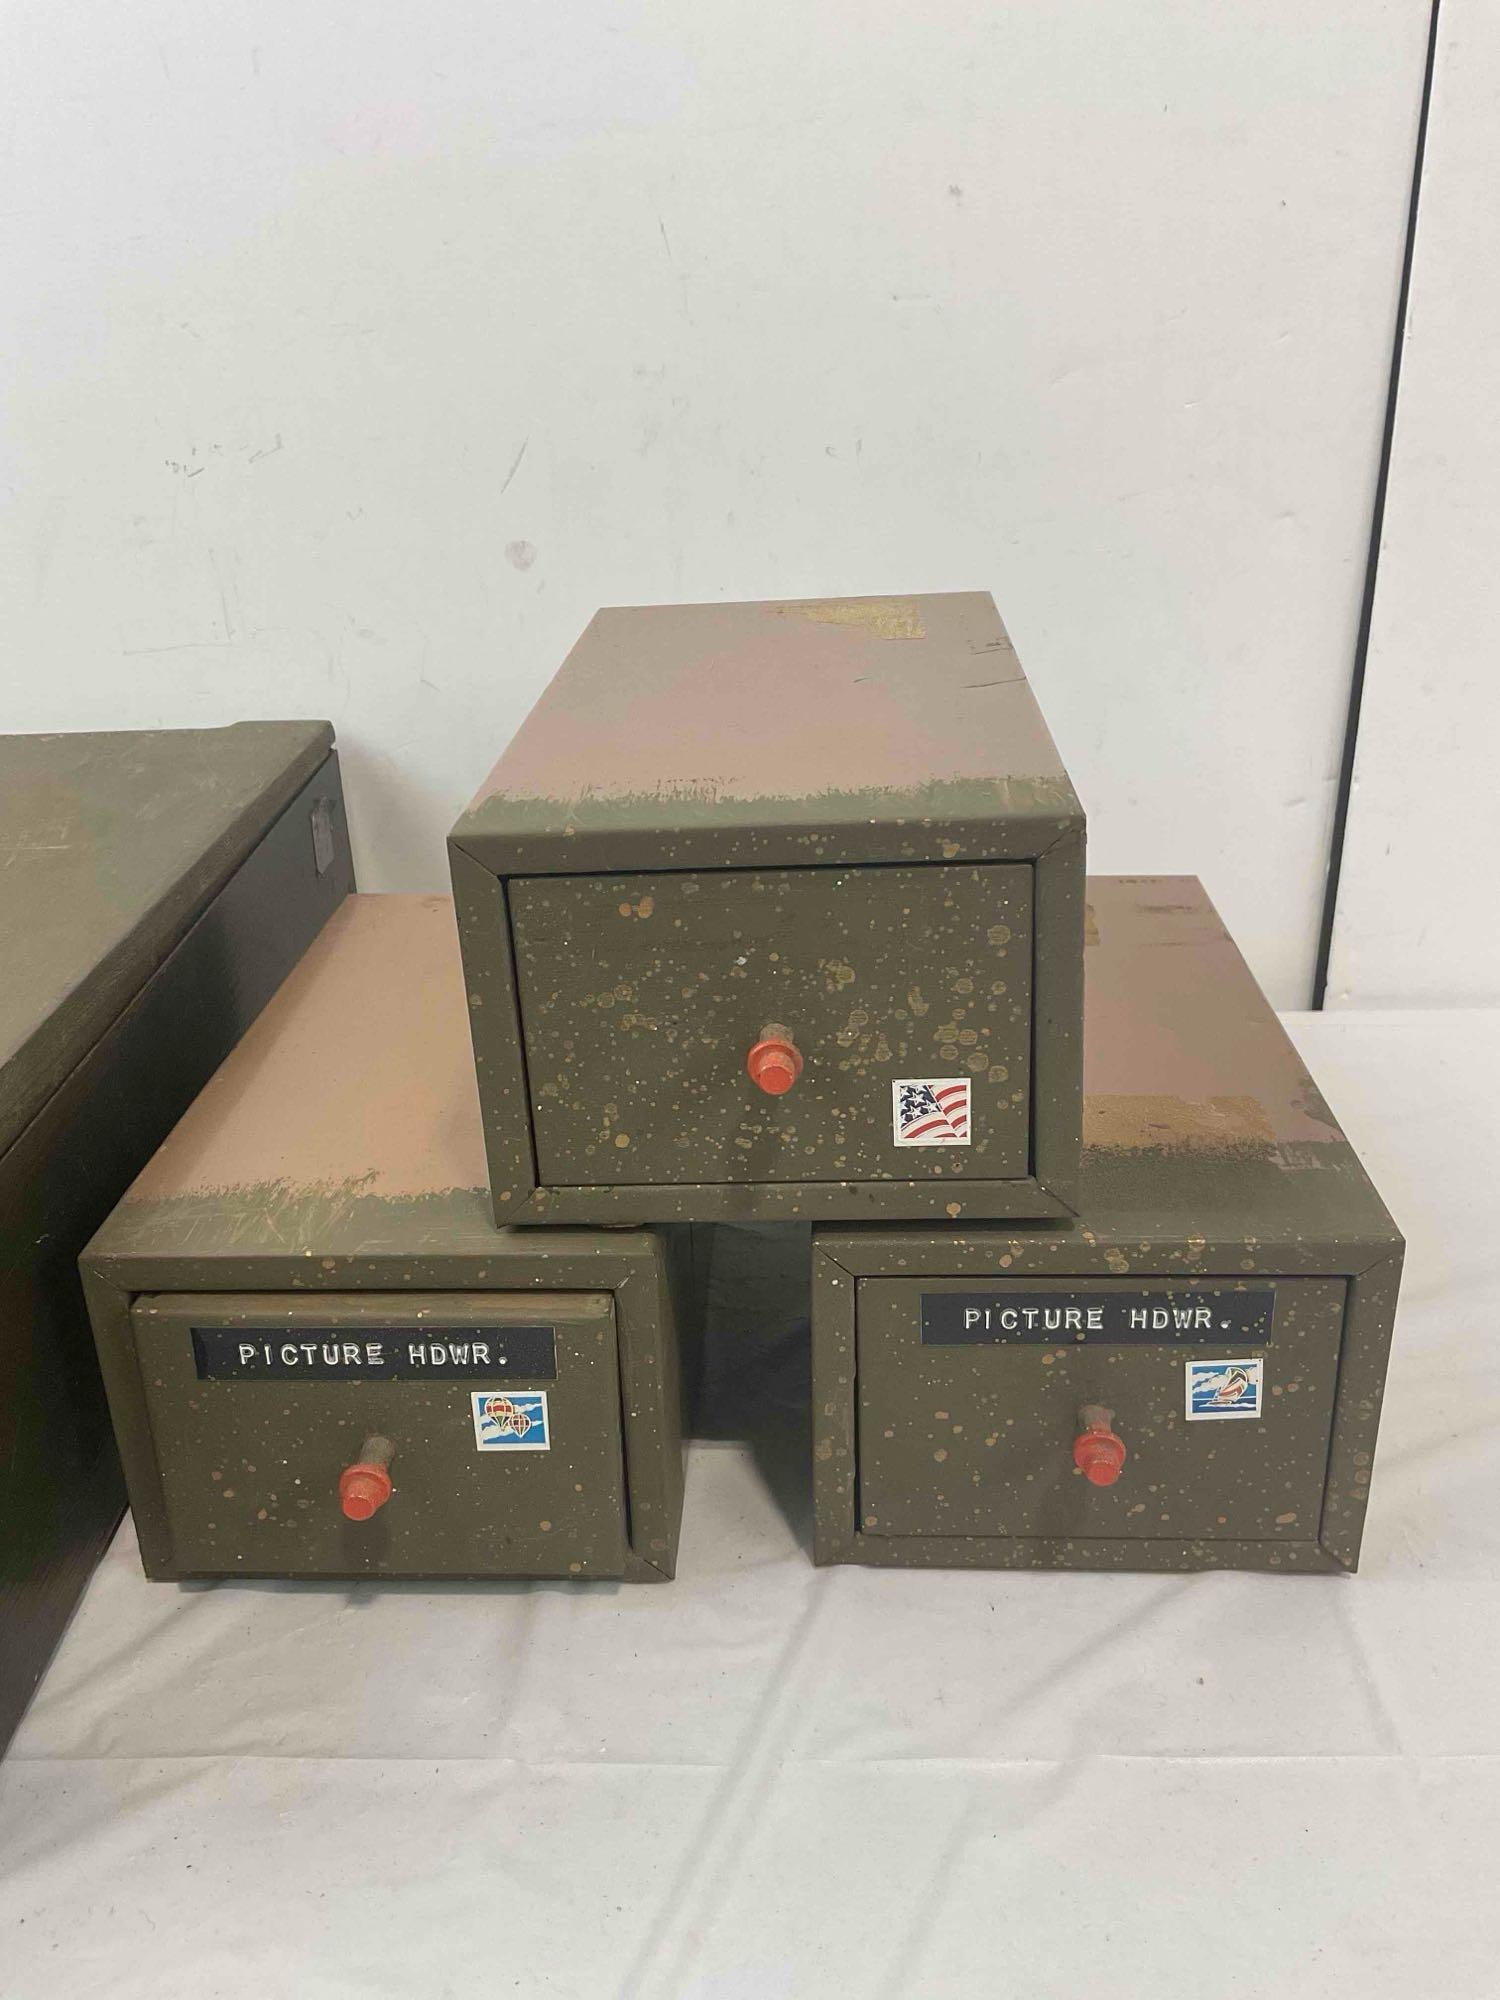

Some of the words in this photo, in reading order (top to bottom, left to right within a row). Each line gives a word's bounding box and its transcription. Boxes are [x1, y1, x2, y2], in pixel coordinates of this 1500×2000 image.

[963, 1307, 1103, 1330] PICTURE
[1130, 1306, 1230, 1330] HDWR.
[238, 1342, 385, 1366] PICTURE
[408, 1341, 508, 1366] HDWR.
